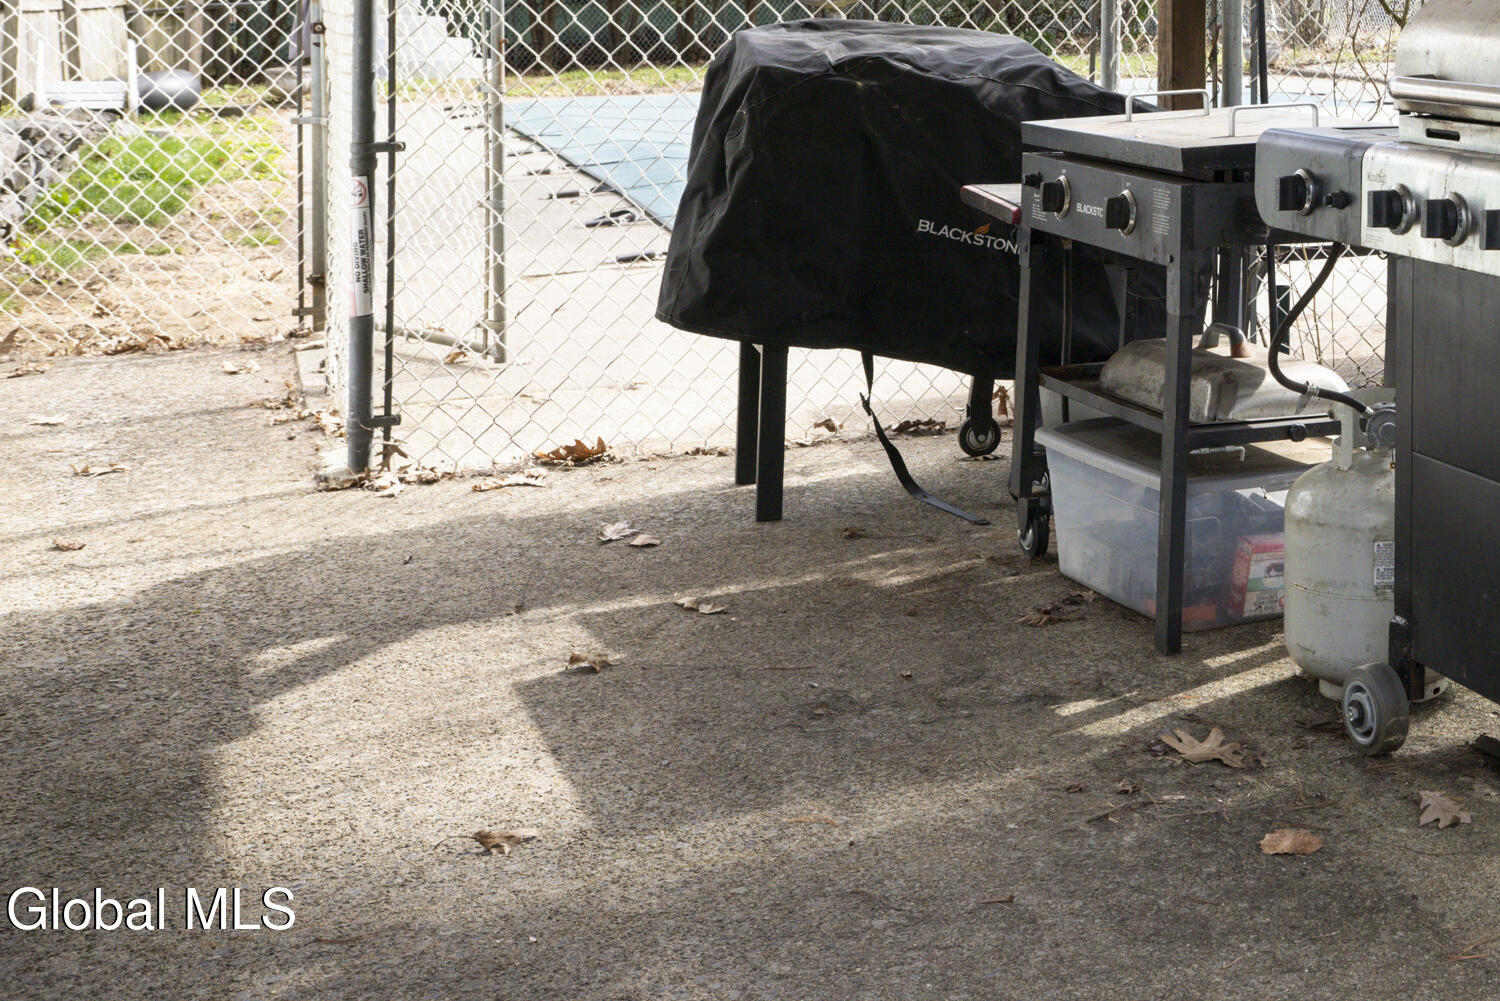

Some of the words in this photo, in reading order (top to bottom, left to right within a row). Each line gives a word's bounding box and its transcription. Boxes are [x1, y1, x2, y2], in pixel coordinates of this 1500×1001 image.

[358, 229, 366, 256] WATER
[918, 219, 1020, 254] BLACKSTON
[352, 241, 360, 269] DIVING
[355, 271, 361, 283] NO
[360, 257, 369, 294] SHALLOW
